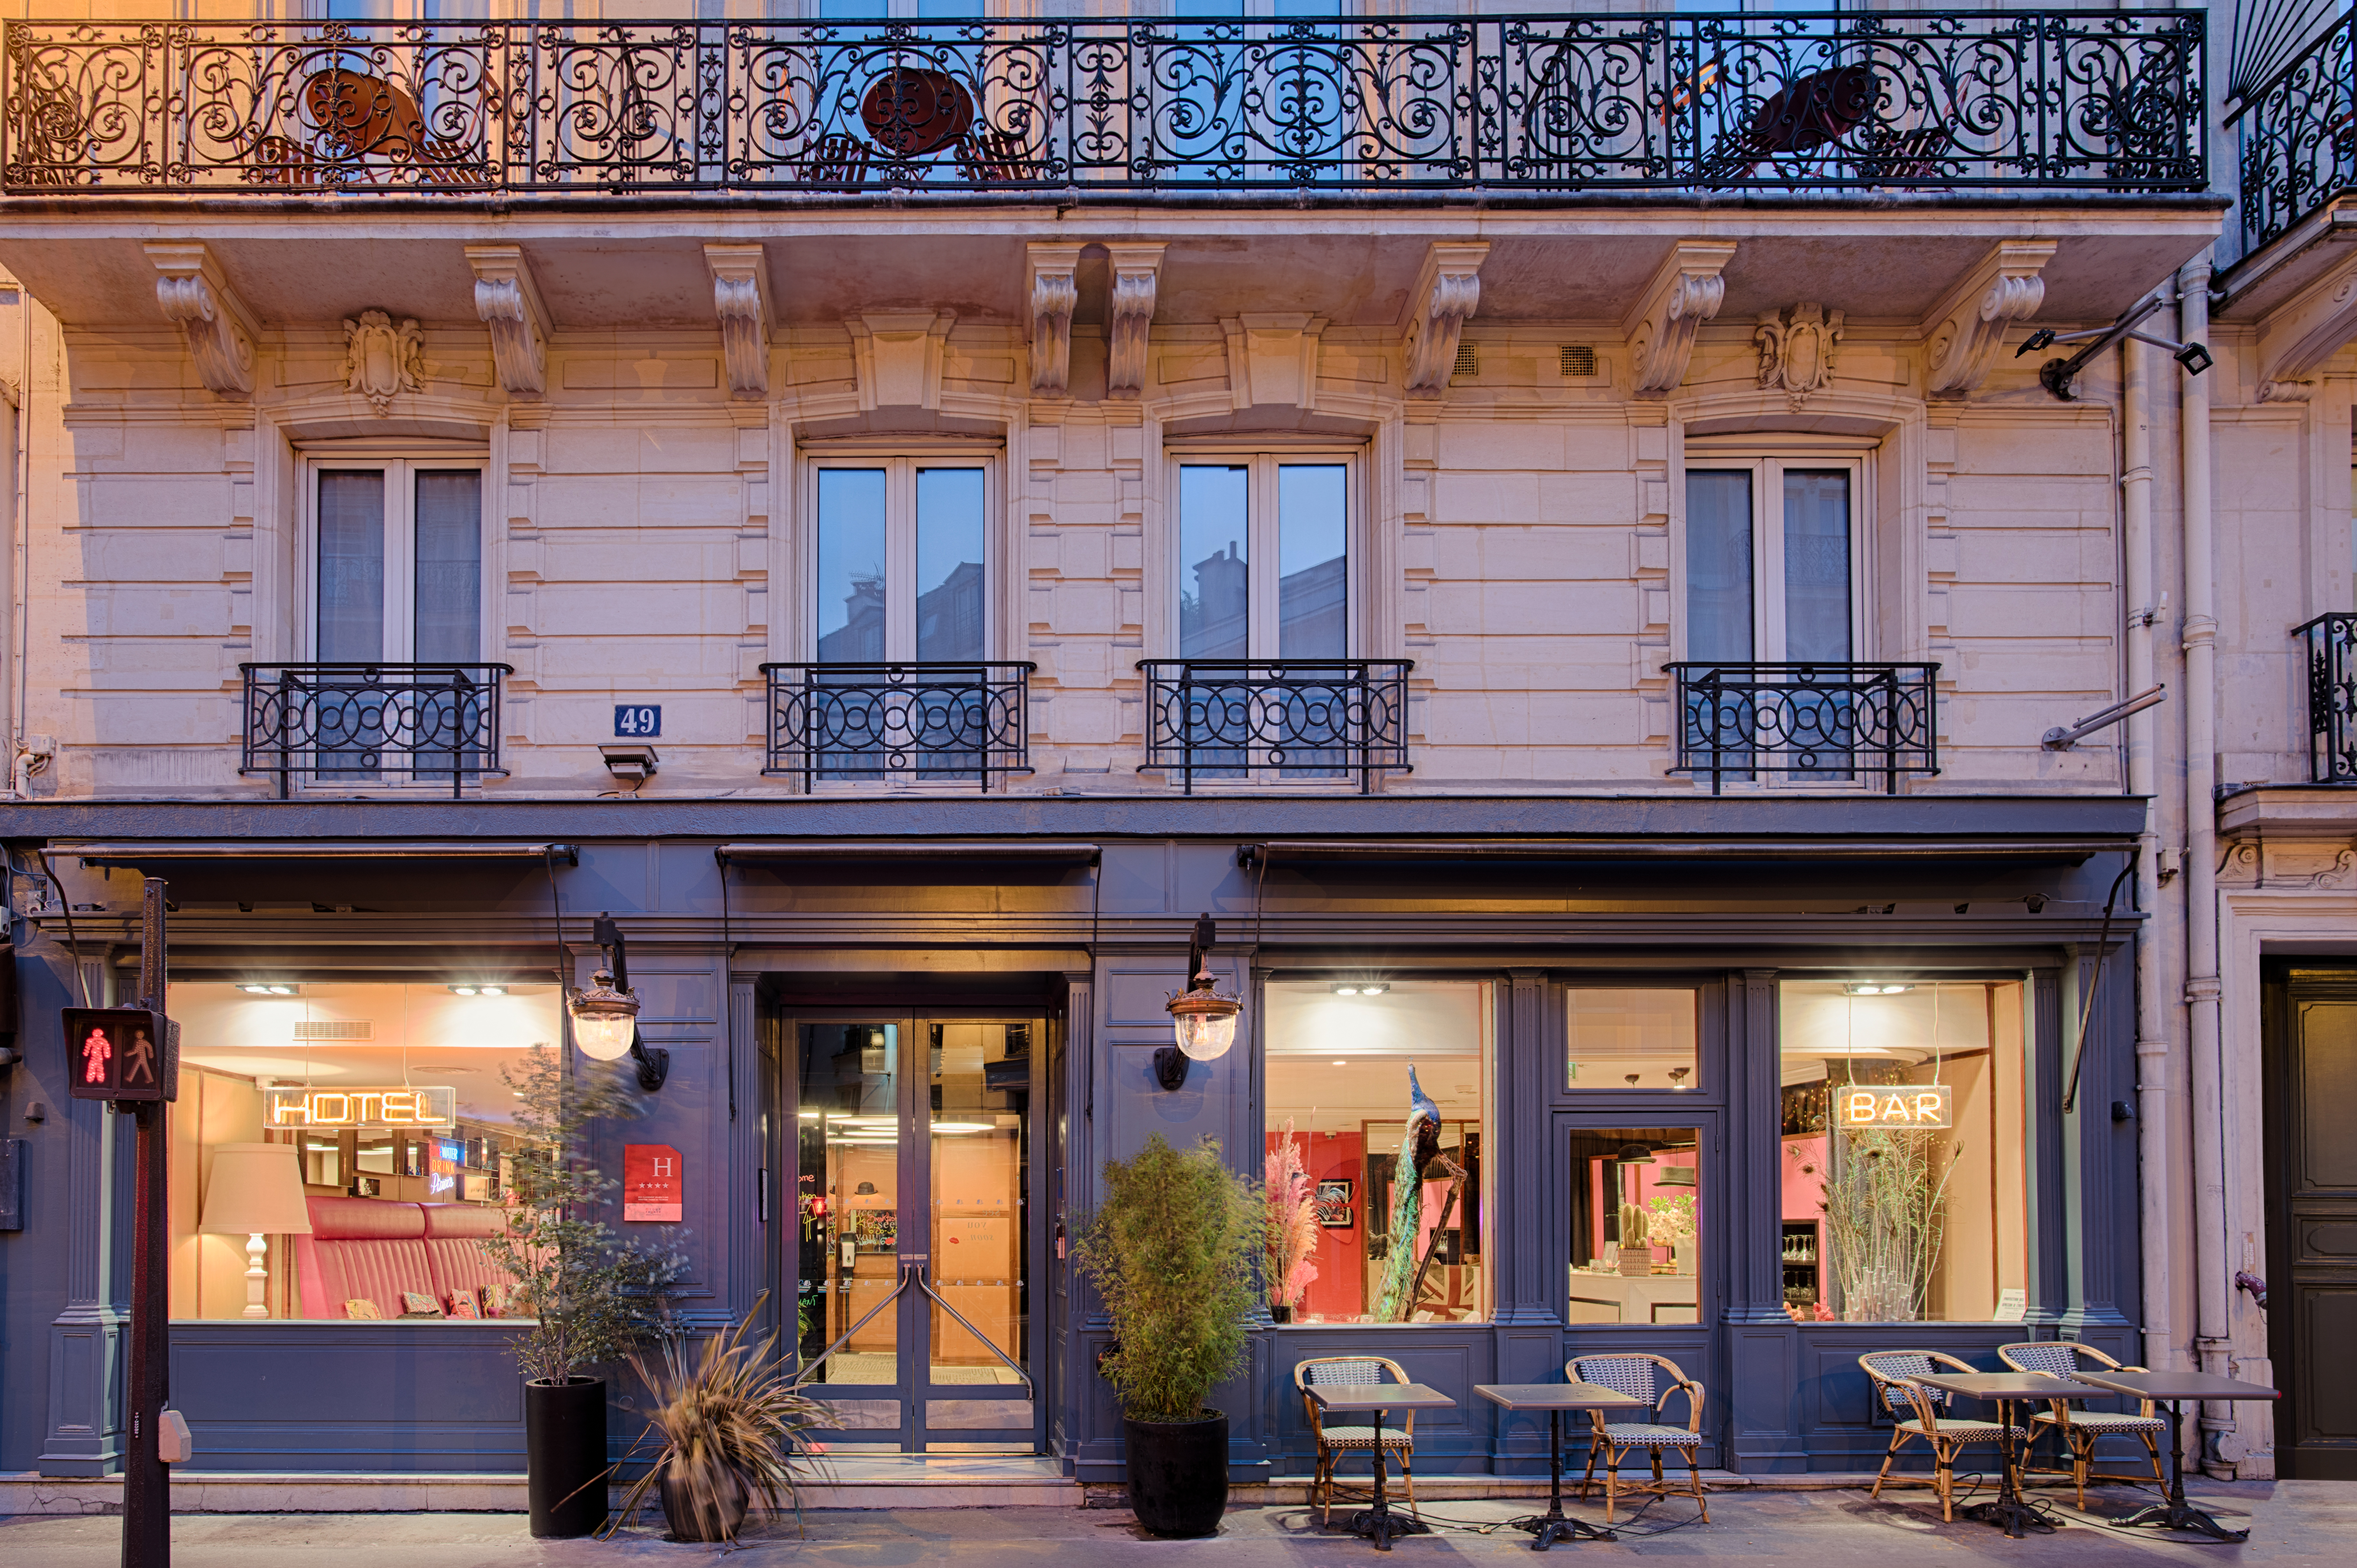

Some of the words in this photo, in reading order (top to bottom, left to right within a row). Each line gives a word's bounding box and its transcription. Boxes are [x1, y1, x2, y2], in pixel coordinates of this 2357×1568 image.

[621, 708, 654, 733] 49
[274, 1092, 447, 1123] HOTEL
[1850, 1093, 1941, 1122] BAR
[441, 1146, 458, 1160] WATER
[432, 1159, 455, 1174] DRINK
[652, 1157, 673, 1177] H
